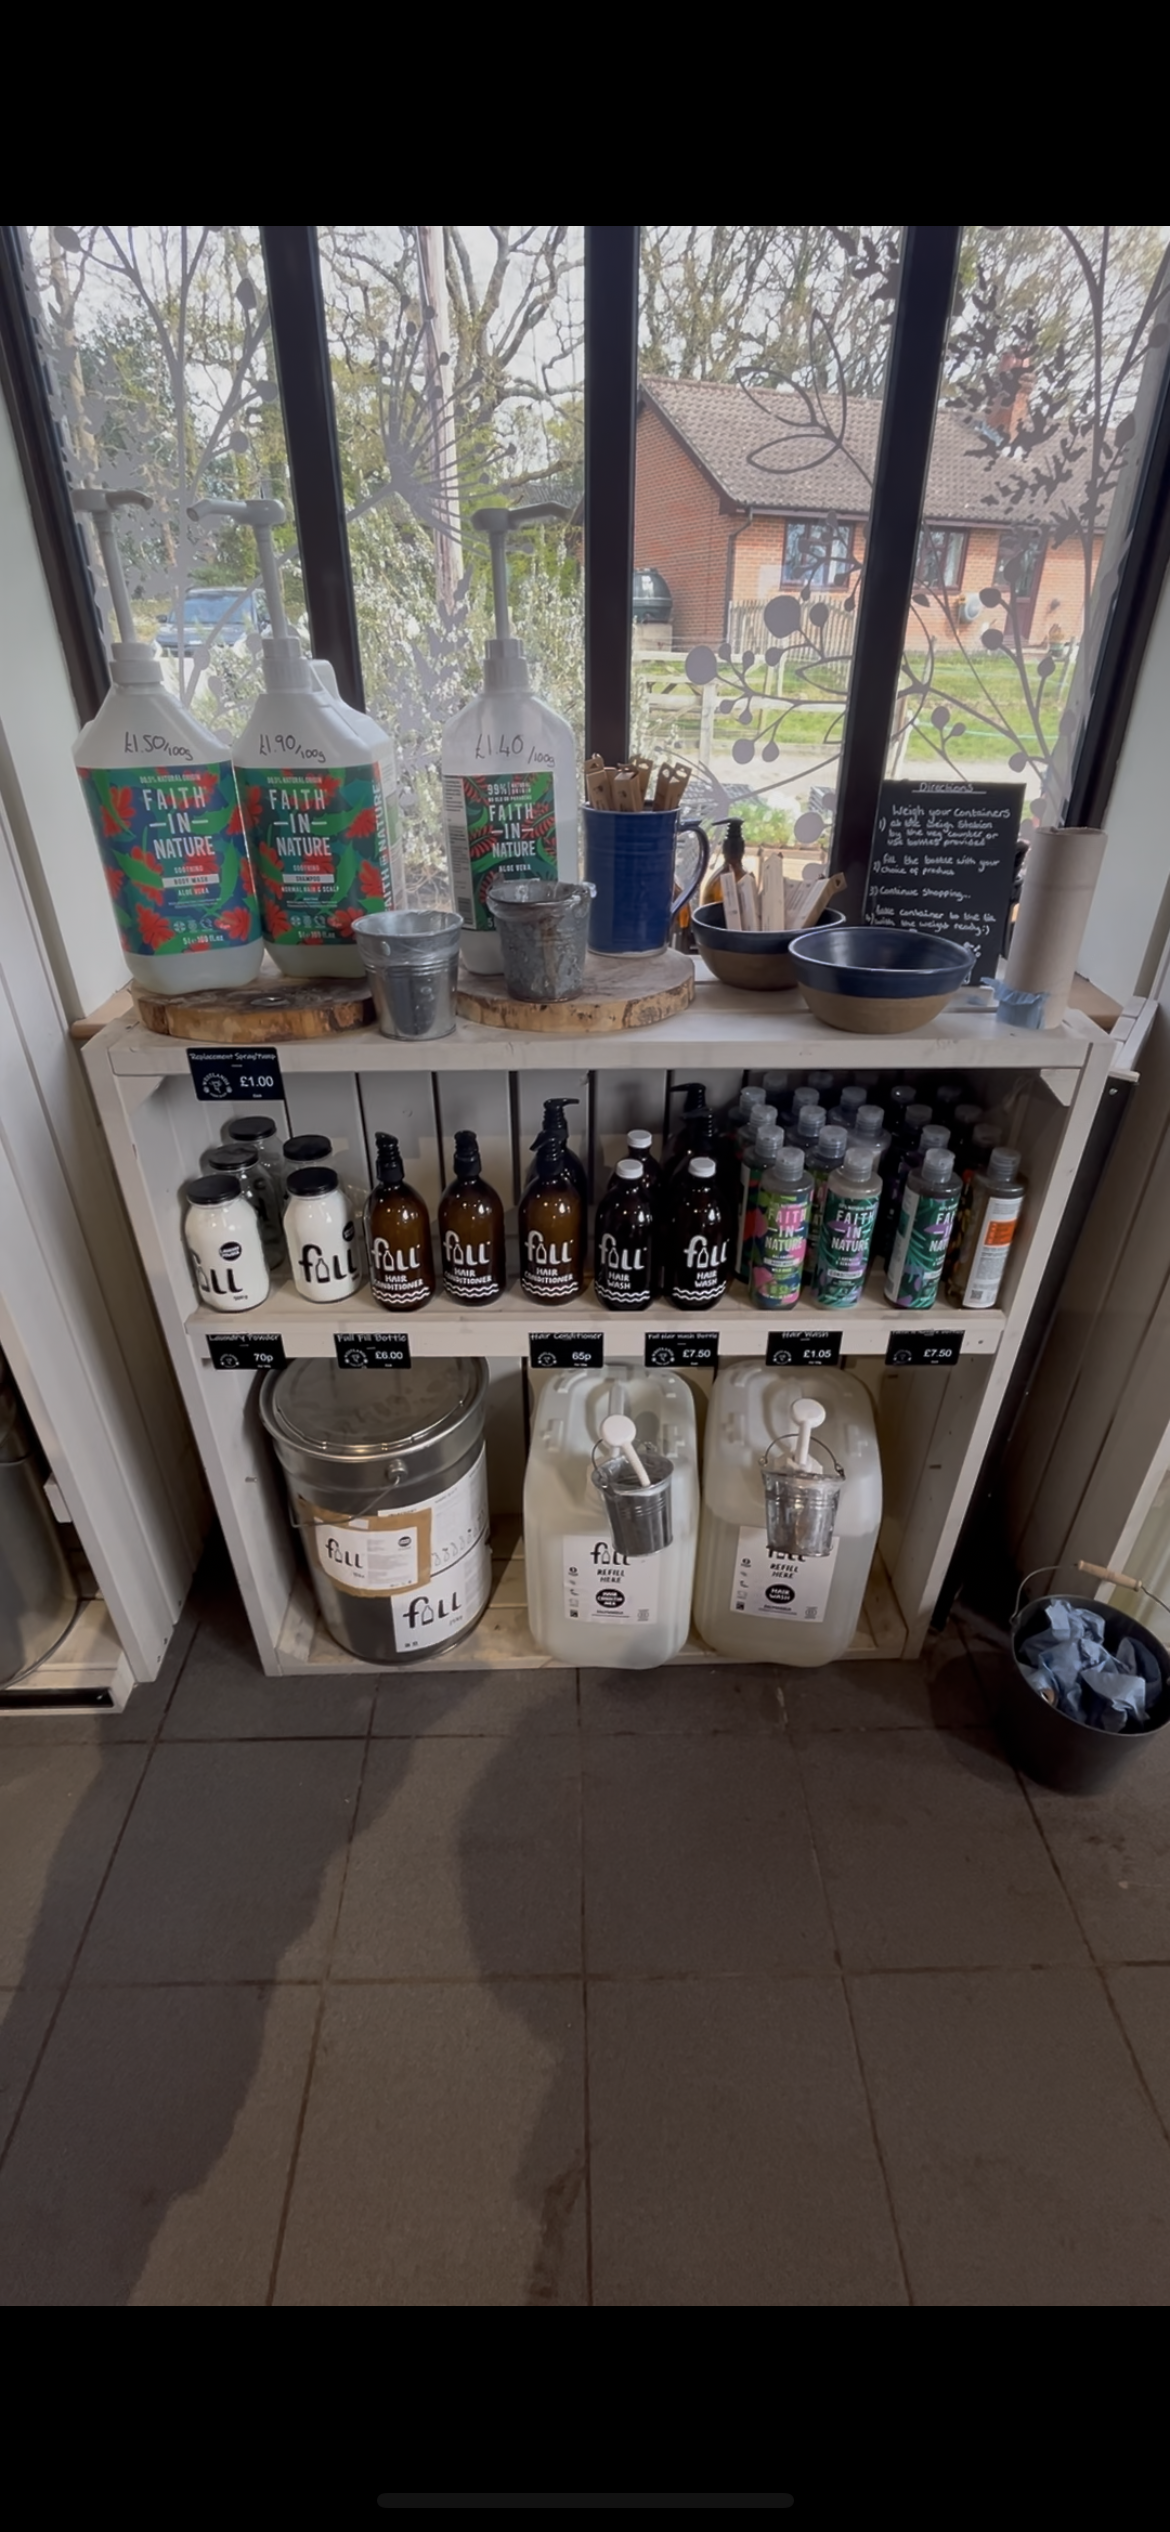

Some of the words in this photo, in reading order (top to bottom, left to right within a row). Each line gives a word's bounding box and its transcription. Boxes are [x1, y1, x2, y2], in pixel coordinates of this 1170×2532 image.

[487, 784, 507, 795] 99%
[920, 782, 974, 792] Directions
[142, 786, 206, 811] FAITH
[269, 789, 326, 810] FAITH
[372, 783, 387, 852] NATURE
[489, 803, 533, 821] FAITH
[892, 804, 925, 821] Weigh
[929, 809, 951, 824] your
[167, 812, 191, 834] IN
[289, 813, 310, 834] IN
[504, 823, 520, 839] IN
[888, 829, 901, 839] by
[906, 829, 923, 837] the
[926, 830, 943, 841] veg
[153, 836, 215, 859] NATURE
[276, 837, 332, 856] NATURE
[943, 838, 985, 848] provided
[492, 841, 536, 858] NATURE
[904, 854, 919, 865] the
[924, 855, 953, 865] bottle
[956, 854, 976, 865] with
[979, 859, 1000, 873] your
[381, 868, 392, 911] AITH
[190, 1052, 233, 1061] Replacement
[240, 1076, 274, 1087] £1.00
[768, 1208, 807, 1224] FAITH
[836, 1210, 874, 1225] FAITH
[779, 1225, 794, 1238] IN
[846, 1226, 862, 1239] IN
[765, 1236, 803, 1252] NATURE
[831, 1237, 869, 1252] NATURE
[454, 1268, 476, 1277] HAIR
[536, 1267, 558, 1276] HAIR
[608, 1271, 630, 1282] HAIR
[697, 1270, 717, 1280] HAIR
[385, 1275, 408, 1283] HAIR
[524, 1272, 573, 1284] CONDITIONER
[694, 1278, 718, 1288] WASH
[607, 1280, 631, 1289] WASH
[375, 1333, 407, 1342] Bottle
[531, 1333, 551, 1341] Hair
[553, 1332, 602, 1341] Conditioner
[253, 1353, 274, 1363] 70p
[375, 1351, 404, 1360] £6.00
[572, 1352, 592, 1362] 65p
[682, 1349, 711, 1358] £7.50
[803, 1349, 832, 1358] £1.05
[923, 1348, 952, 1358] £7.50
[597, 1568, 625, 1577] REFILL
[770, 1563, 799, 1573] REFILL
[772, 1571, 794, 1579] HERE
[769, 1593, 791, 1601] WASH
